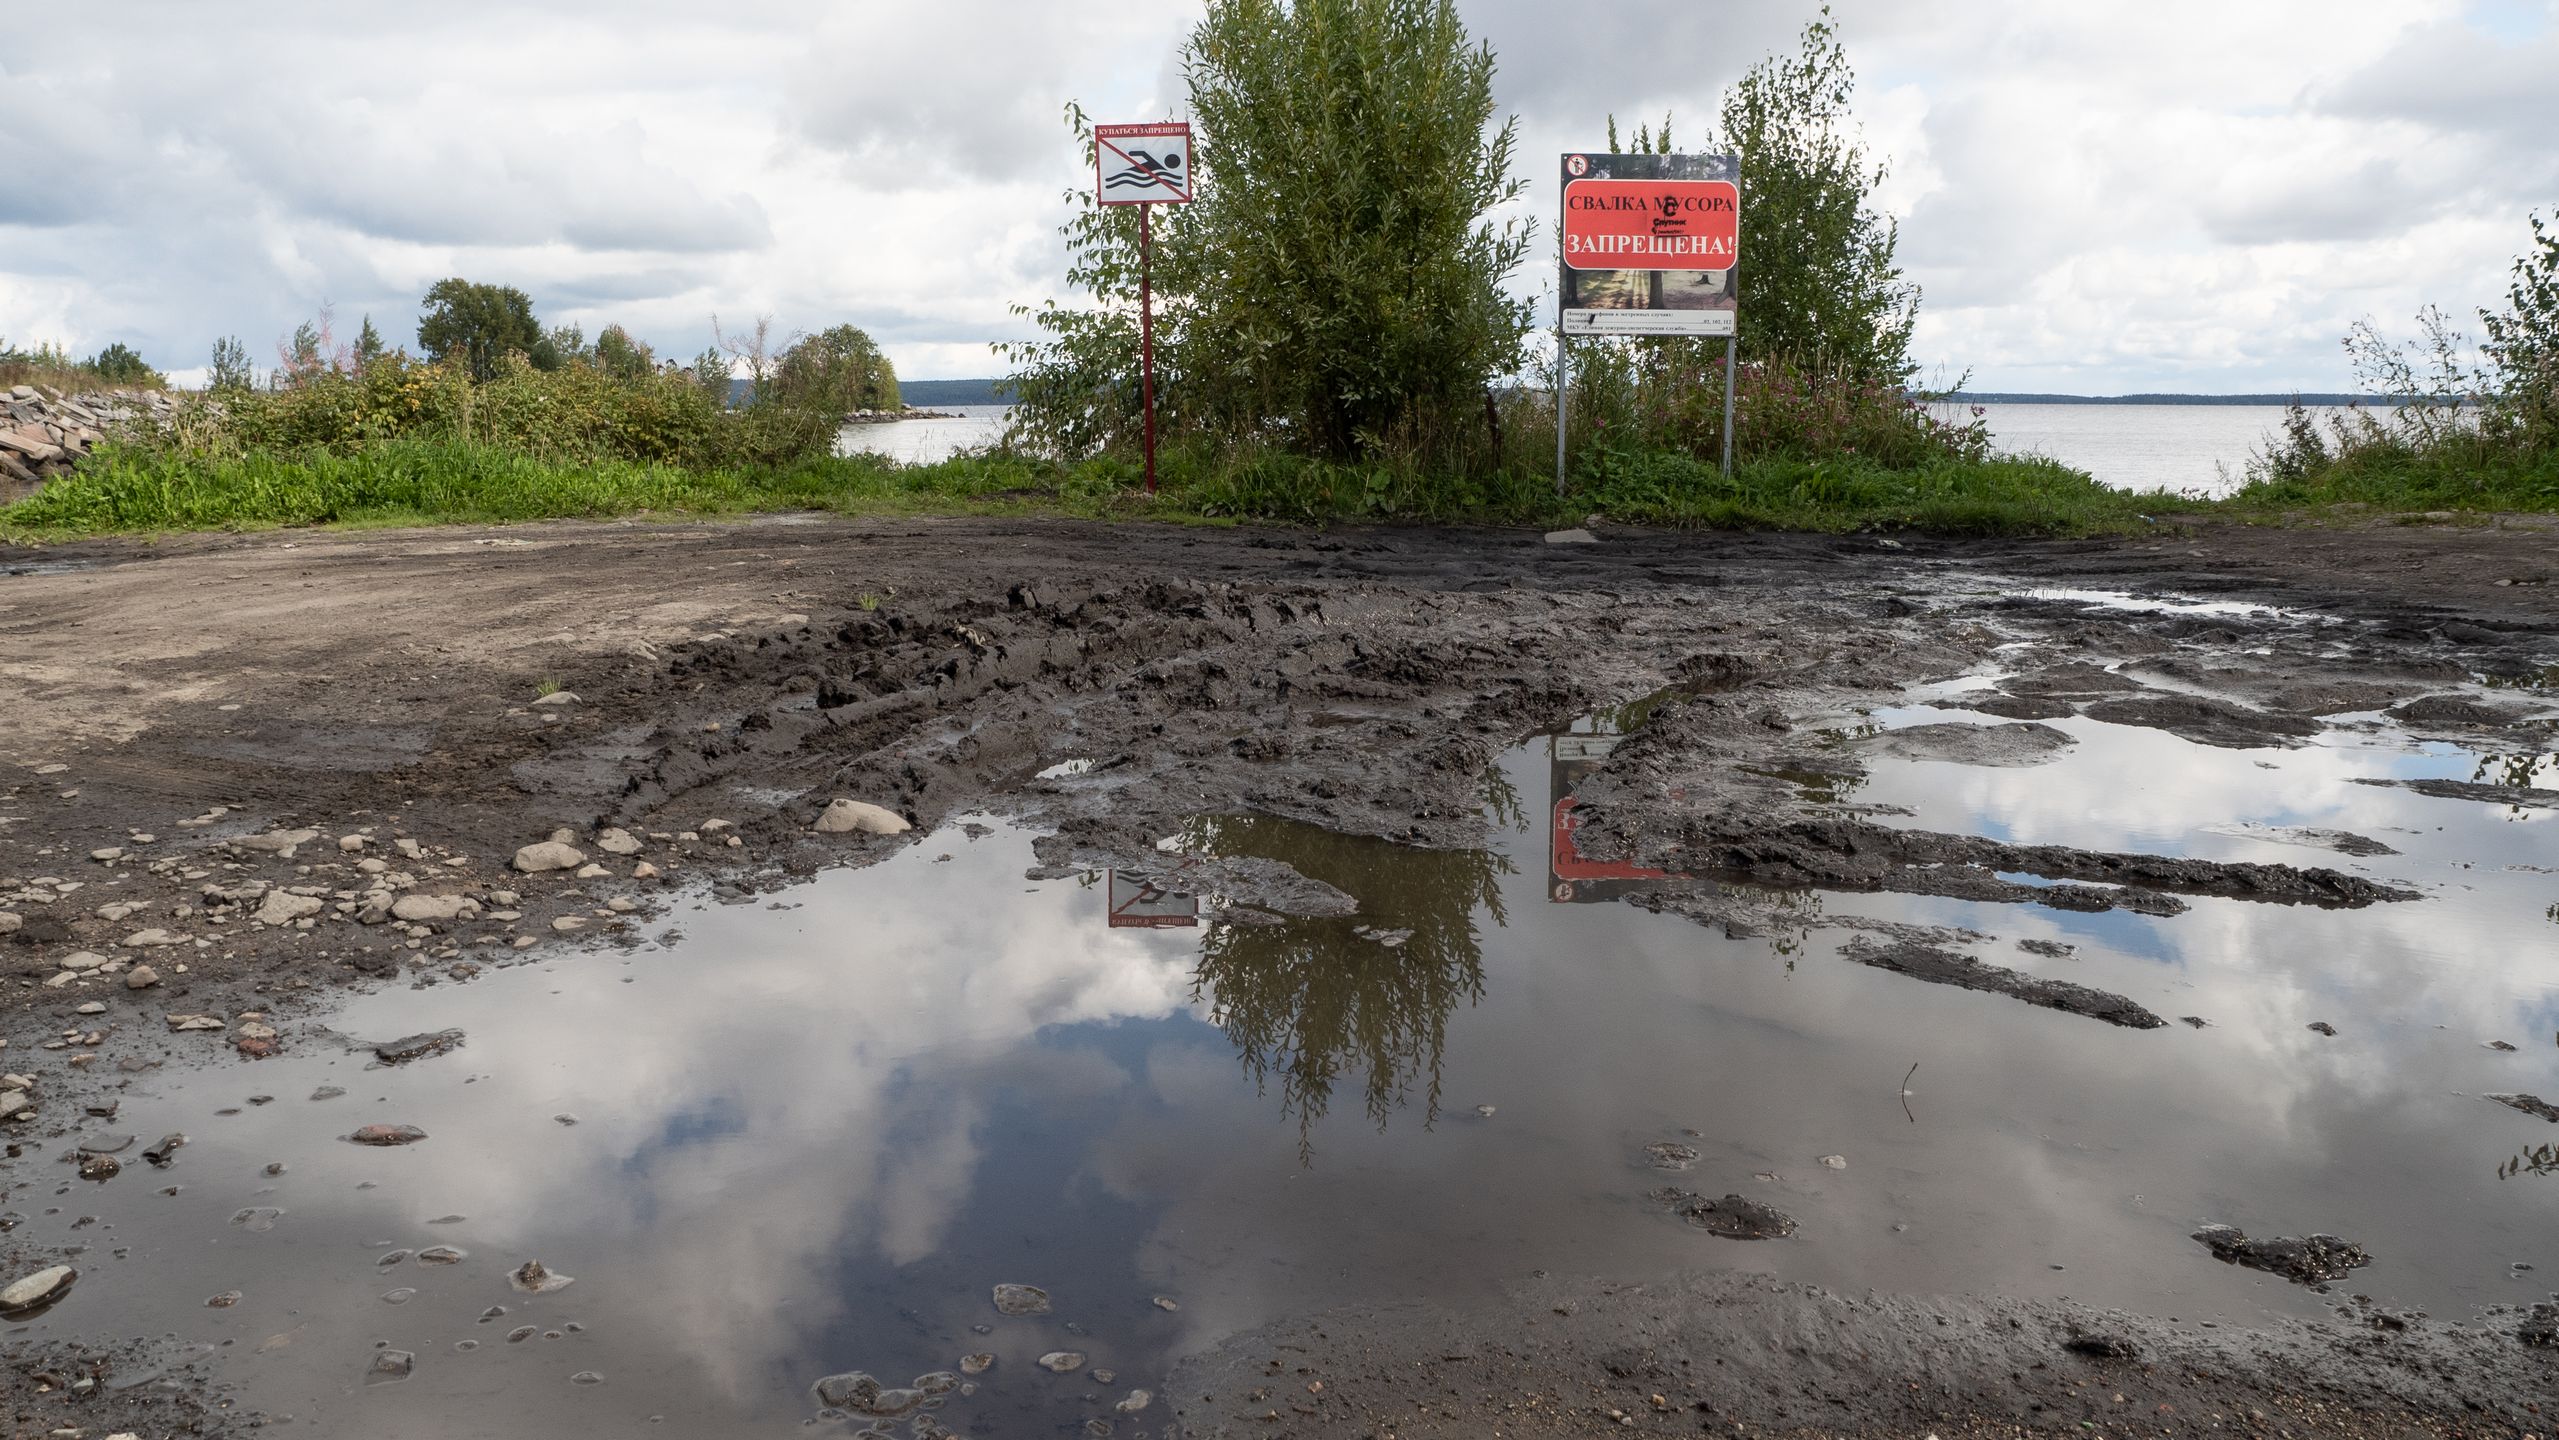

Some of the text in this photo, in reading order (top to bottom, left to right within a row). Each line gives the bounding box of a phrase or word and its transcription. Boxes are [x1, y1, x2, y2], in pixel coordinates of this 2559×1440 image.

[1140, 126, 1186, 134] ЗАПРЕЩЕНО
[1569, 195, 1648, 211] СВАЛКА
[1653, 196, 1734, 212] МУСОРА
[1567, 234, 1733, 257] ЗАПРЕЩЕНА!
